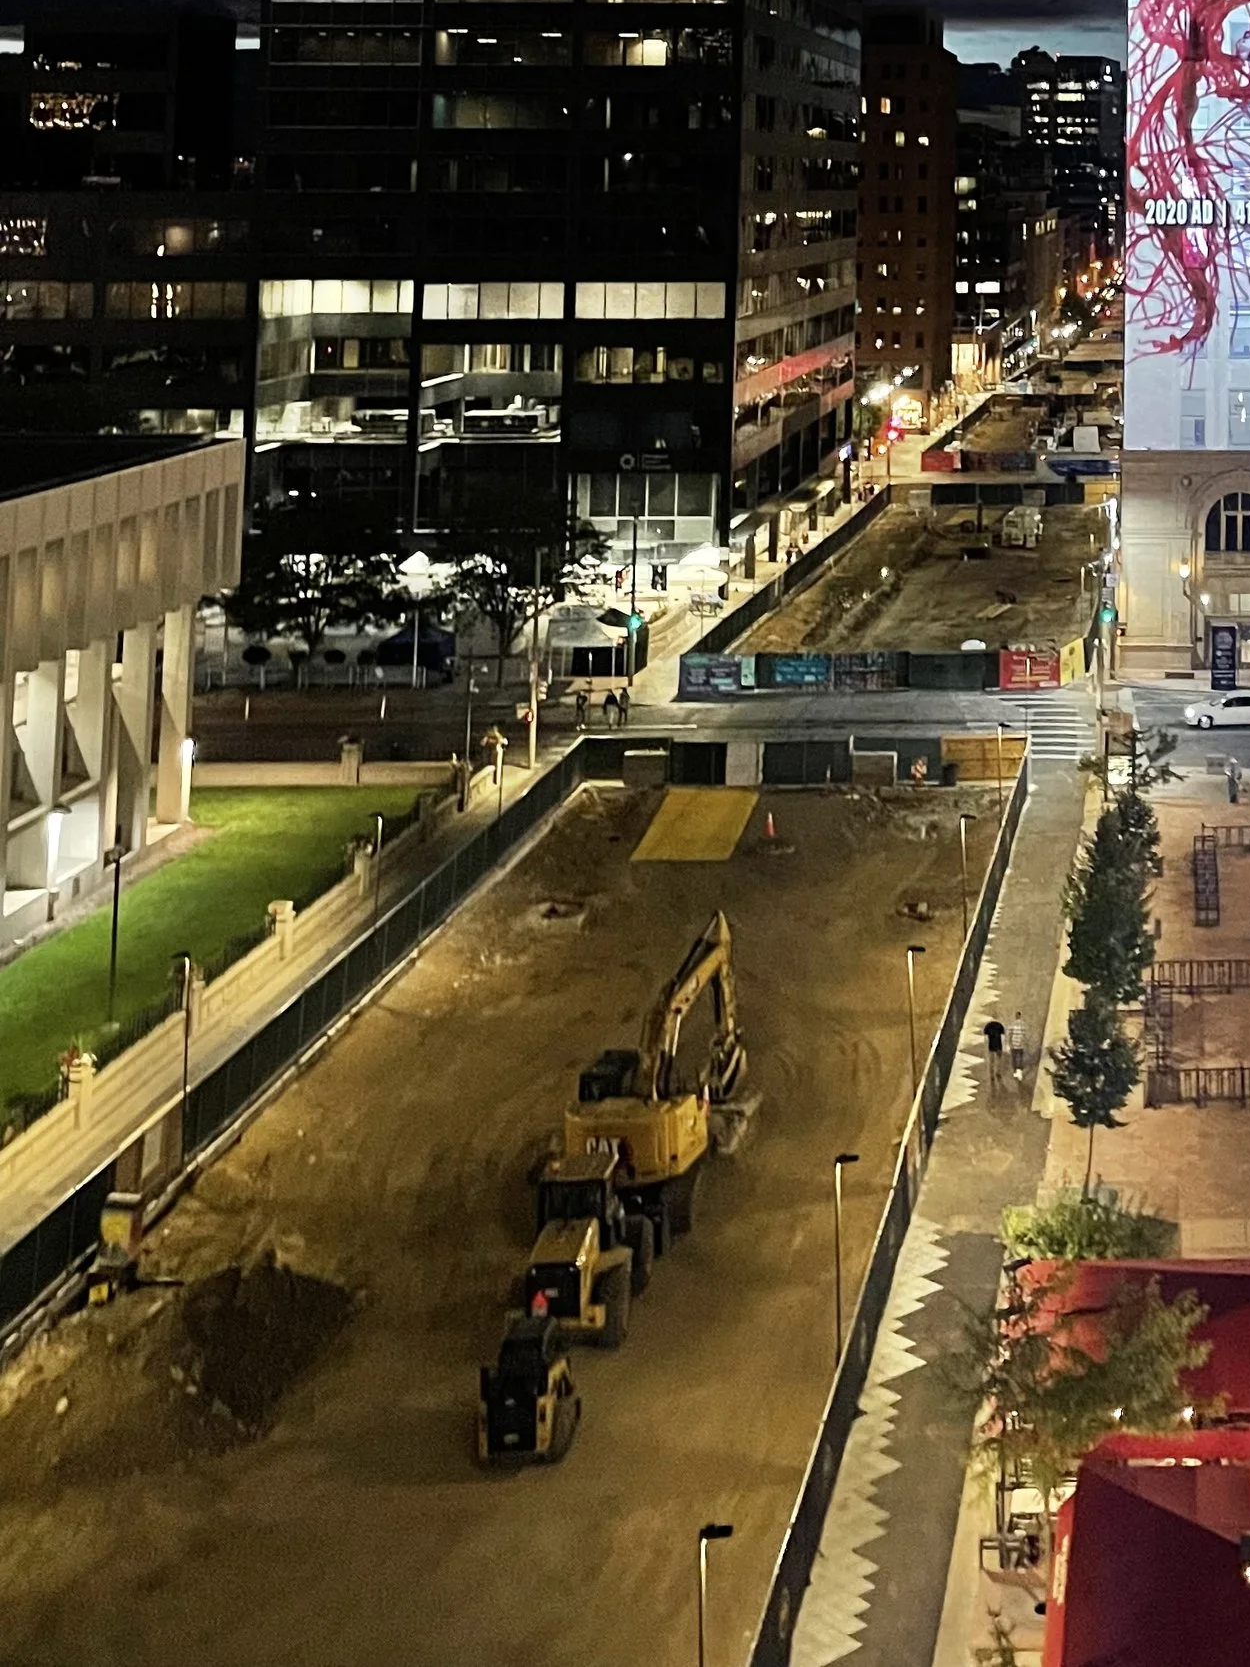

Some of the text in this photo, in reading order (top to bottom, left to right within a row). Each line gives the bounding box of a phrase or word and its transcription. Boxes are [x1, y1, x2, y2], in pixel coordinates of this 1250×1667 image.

[1144, 199, 1188, 224] 2020
[1191, 199, 1214, 224] AD
[586, 1136, 621, 1155] CAT
